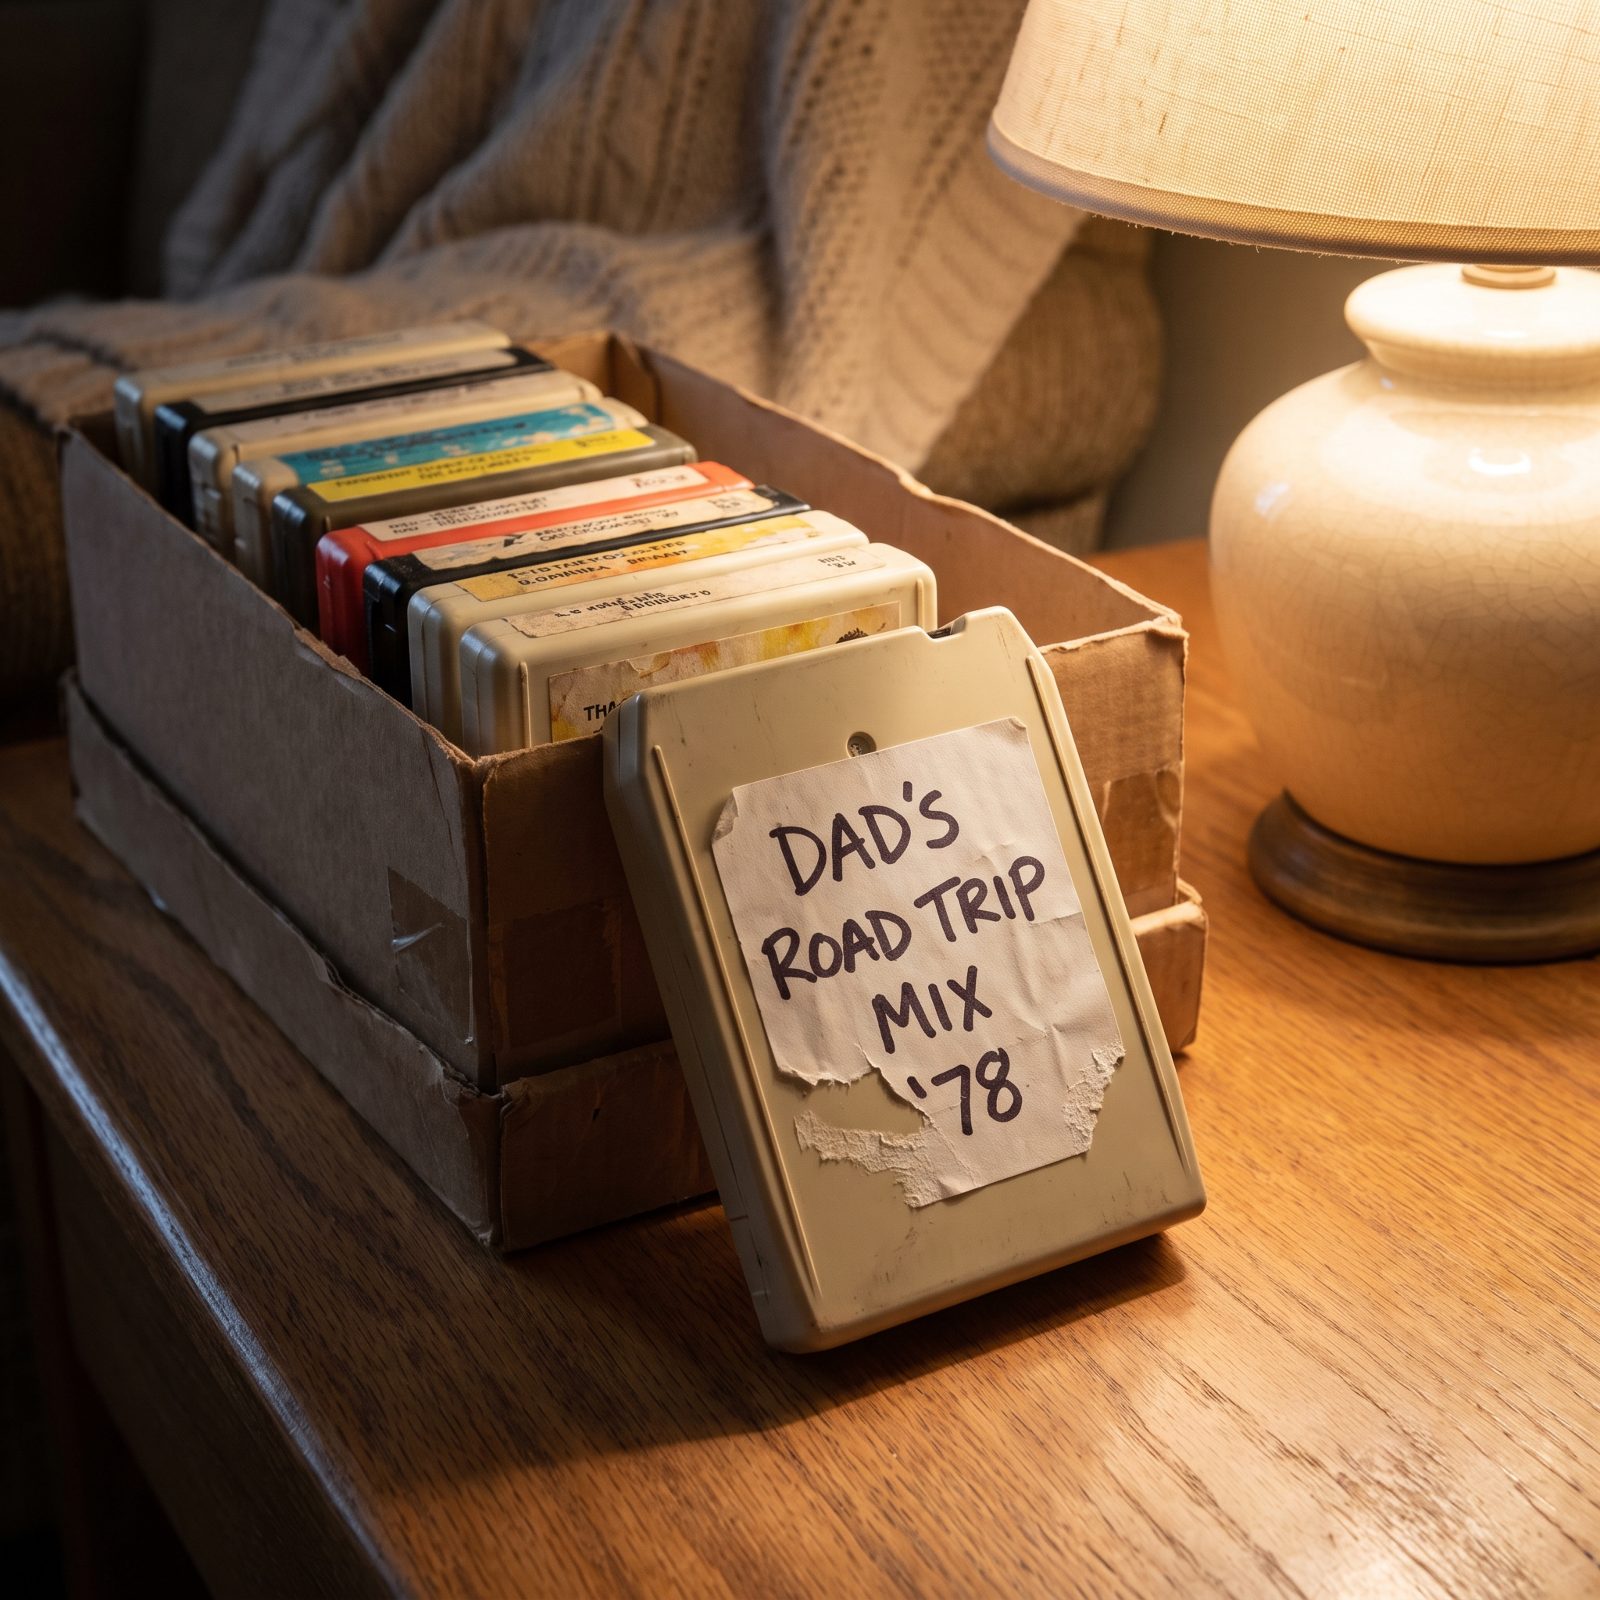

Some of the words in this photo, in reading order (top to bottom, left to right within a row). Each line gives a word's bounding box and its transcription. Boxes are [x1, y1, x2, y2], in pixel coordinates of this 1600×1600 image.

[770, 781, 960, 897] DAD'S
[762, 910, 912, 1001] ROAD
[914, 855, 1046, 943] TRIP
[872, 966, 992, 1054] MIX
[907, 1047, 1023, 1136] '78
